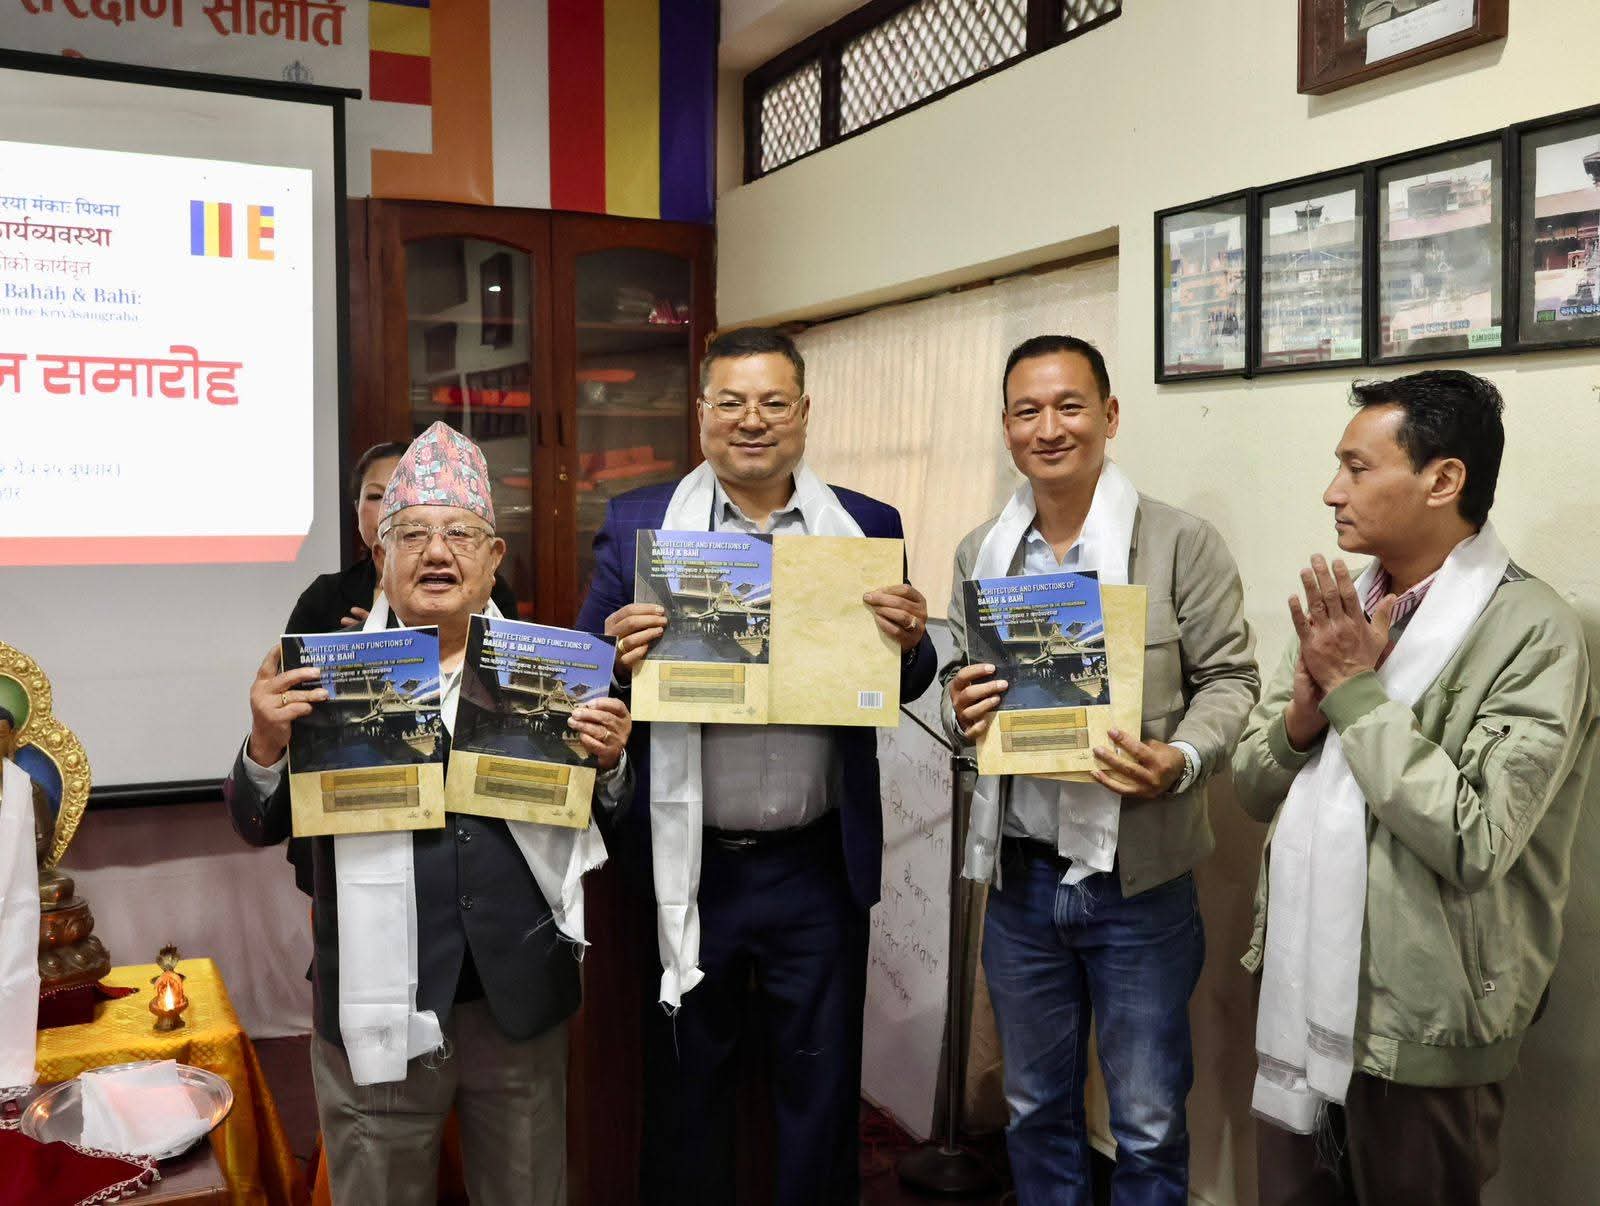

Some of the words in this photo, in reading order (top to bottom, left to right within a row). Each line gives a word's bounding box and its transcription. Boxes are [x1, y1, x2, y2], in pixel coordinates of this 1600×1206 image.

[0, 215, 112, 247] ार्यव्यवस्था
[72, 287, 86, 302] &
[36, 345, 243, 406] समारोह
[977, 586, 1019, 596] ARCHITECTURE
[1020, 584, 1032, 593] AND
[1033, 582, 1066, 592] FUNCTIONS
[1066, 581, 1075, 589] OF
[299, 643, 350, 655] ARCHITECTURE
[351, 642, 365, 651] AND
[366, 639, 403, 649] FUNCTIONS
[404, 638, 413, 647] OF
[484, 629, 531, 643] ARCHITECTURE
[532, 636, 546, 645] AND
[547, 639, 583, 650] FUNCTIONS
[583, 643, 593, 651] OF
